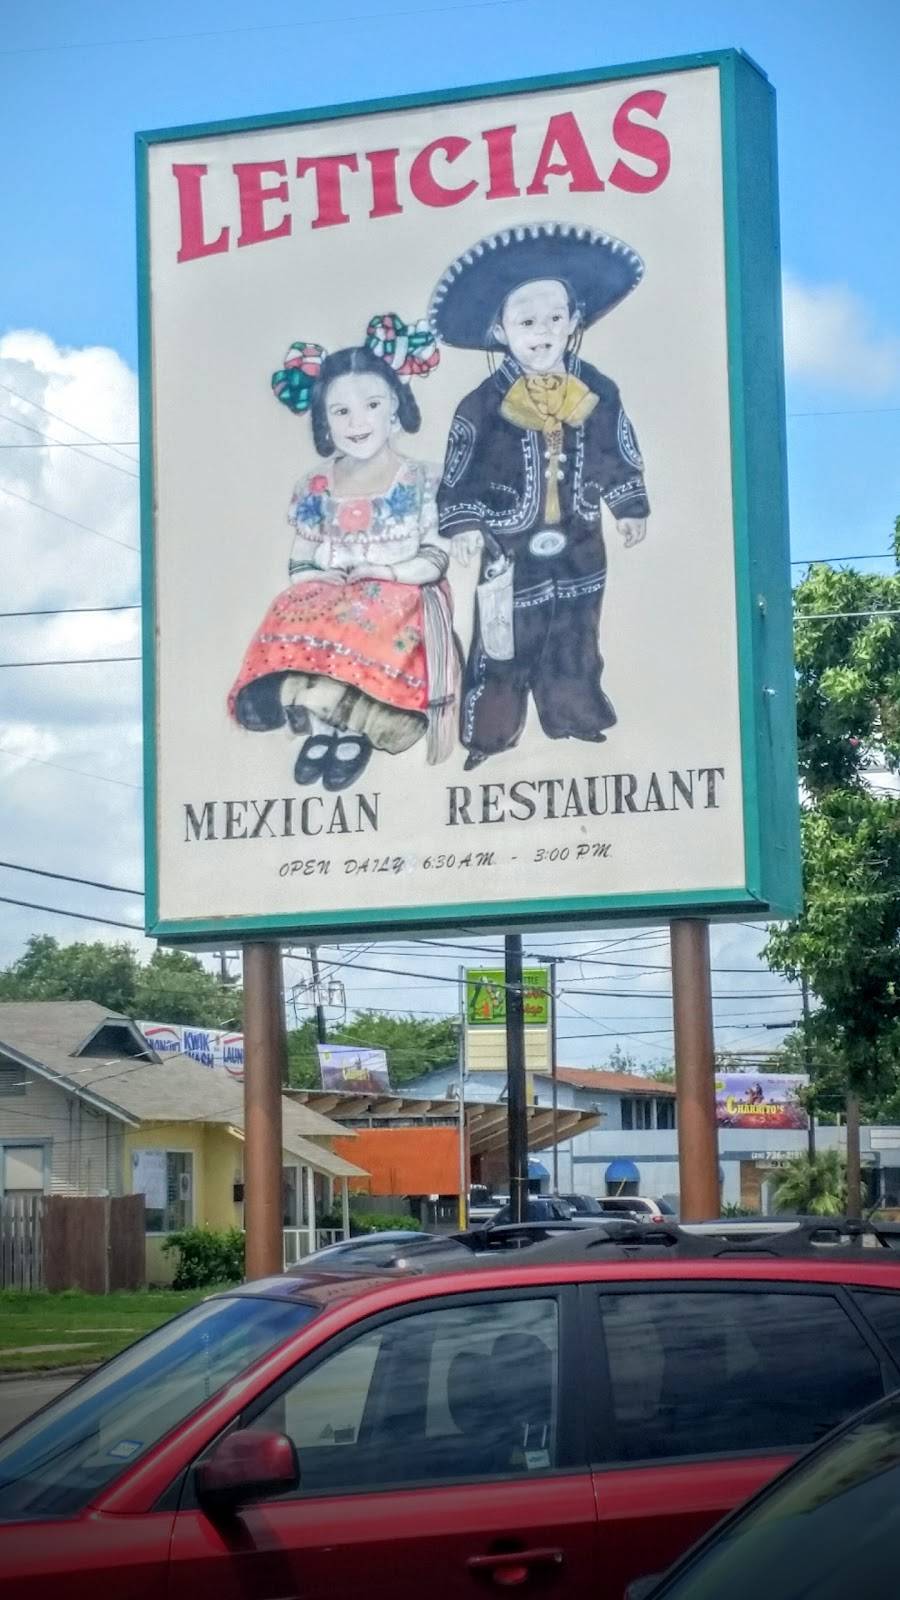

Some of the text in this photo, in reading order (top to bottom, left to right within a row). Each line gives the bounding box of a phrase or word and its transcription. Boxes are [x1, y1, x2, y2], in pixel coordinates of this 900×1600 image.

[172, 90, 672, 263] LETICIAS
[183, 767, 725, 842] MEXICAN RESTAURANT
[279, 858, 331, 877] OPEN
[343, 856, 405, 875] DAILY
[534, 846, 570, 862] 3:00
